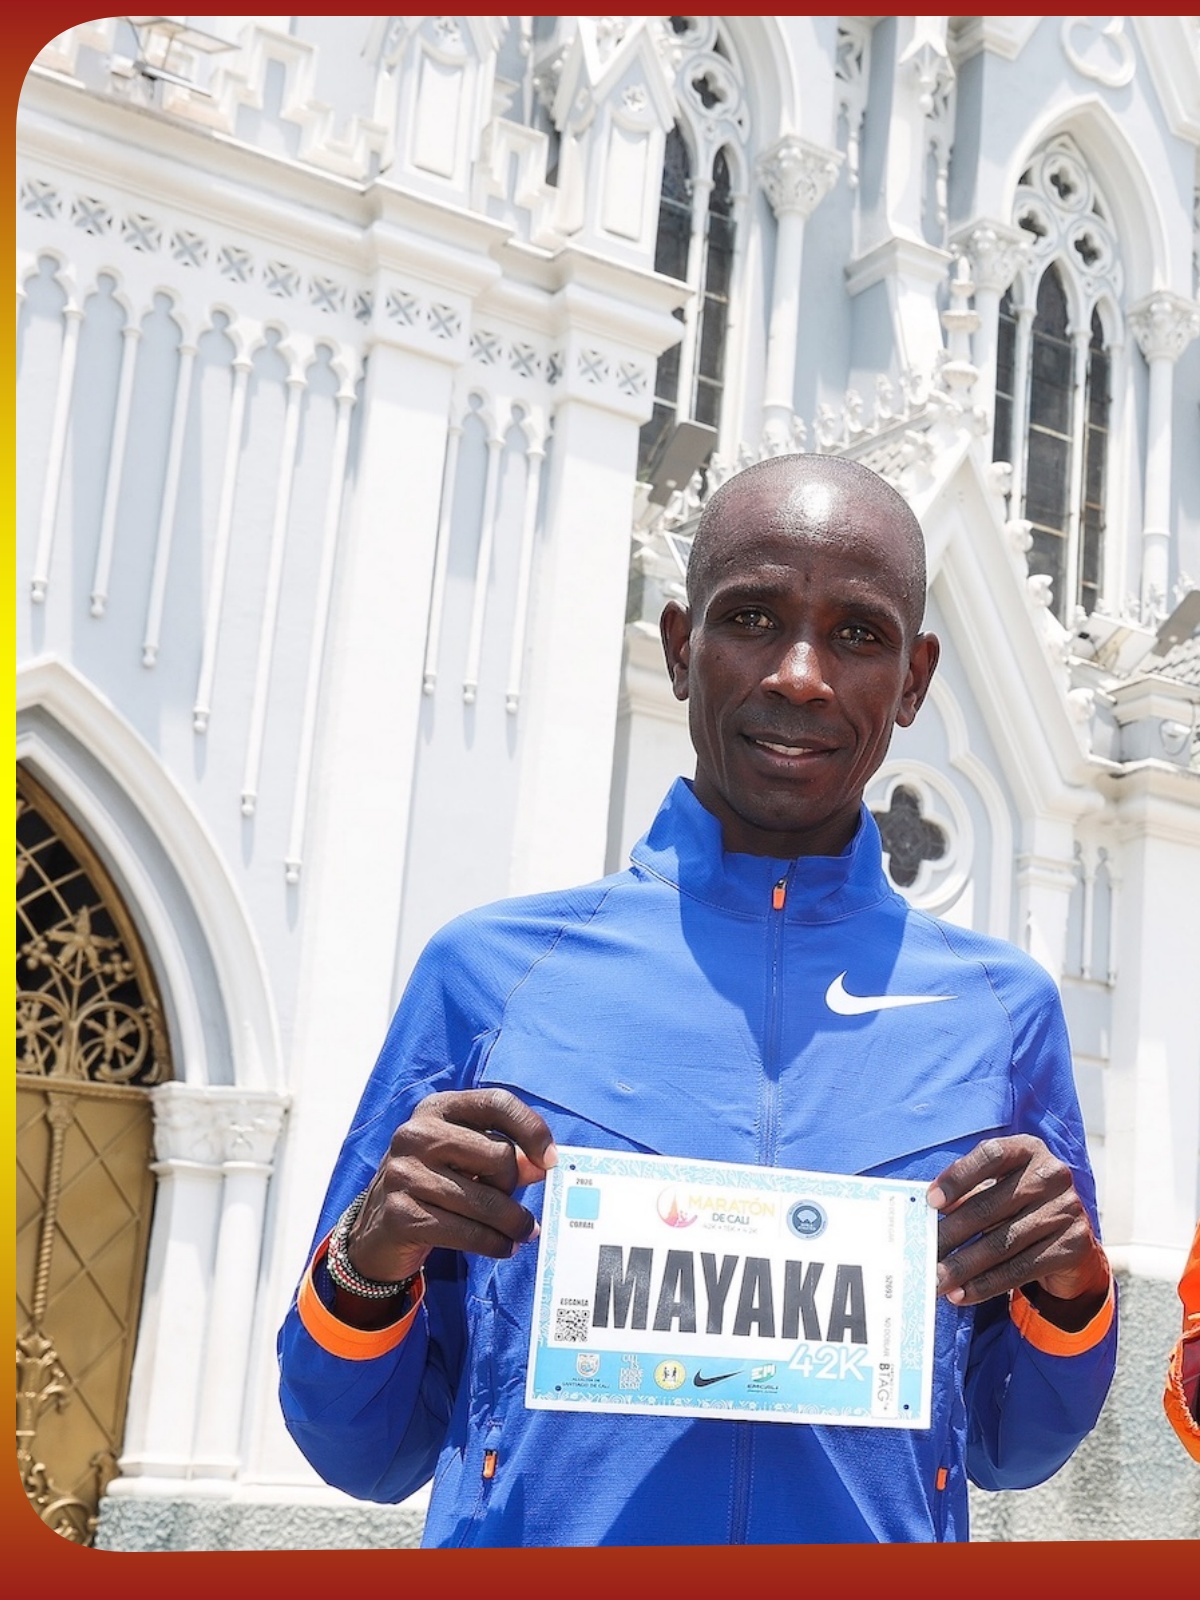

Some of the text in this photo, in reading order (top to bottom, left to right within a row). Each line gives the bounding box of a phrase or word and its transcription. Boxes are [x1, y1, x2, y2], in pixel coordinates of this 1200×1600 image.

[688, 1194, 775, 1217] MARATÓN
[712, 1213, 750, 1225] DE CALI
[592, 1244, 868, 1344] MAYAKA
[788, 1343, 868, 1382] 42K
[877, 1363, 891, 1402] BTAG
